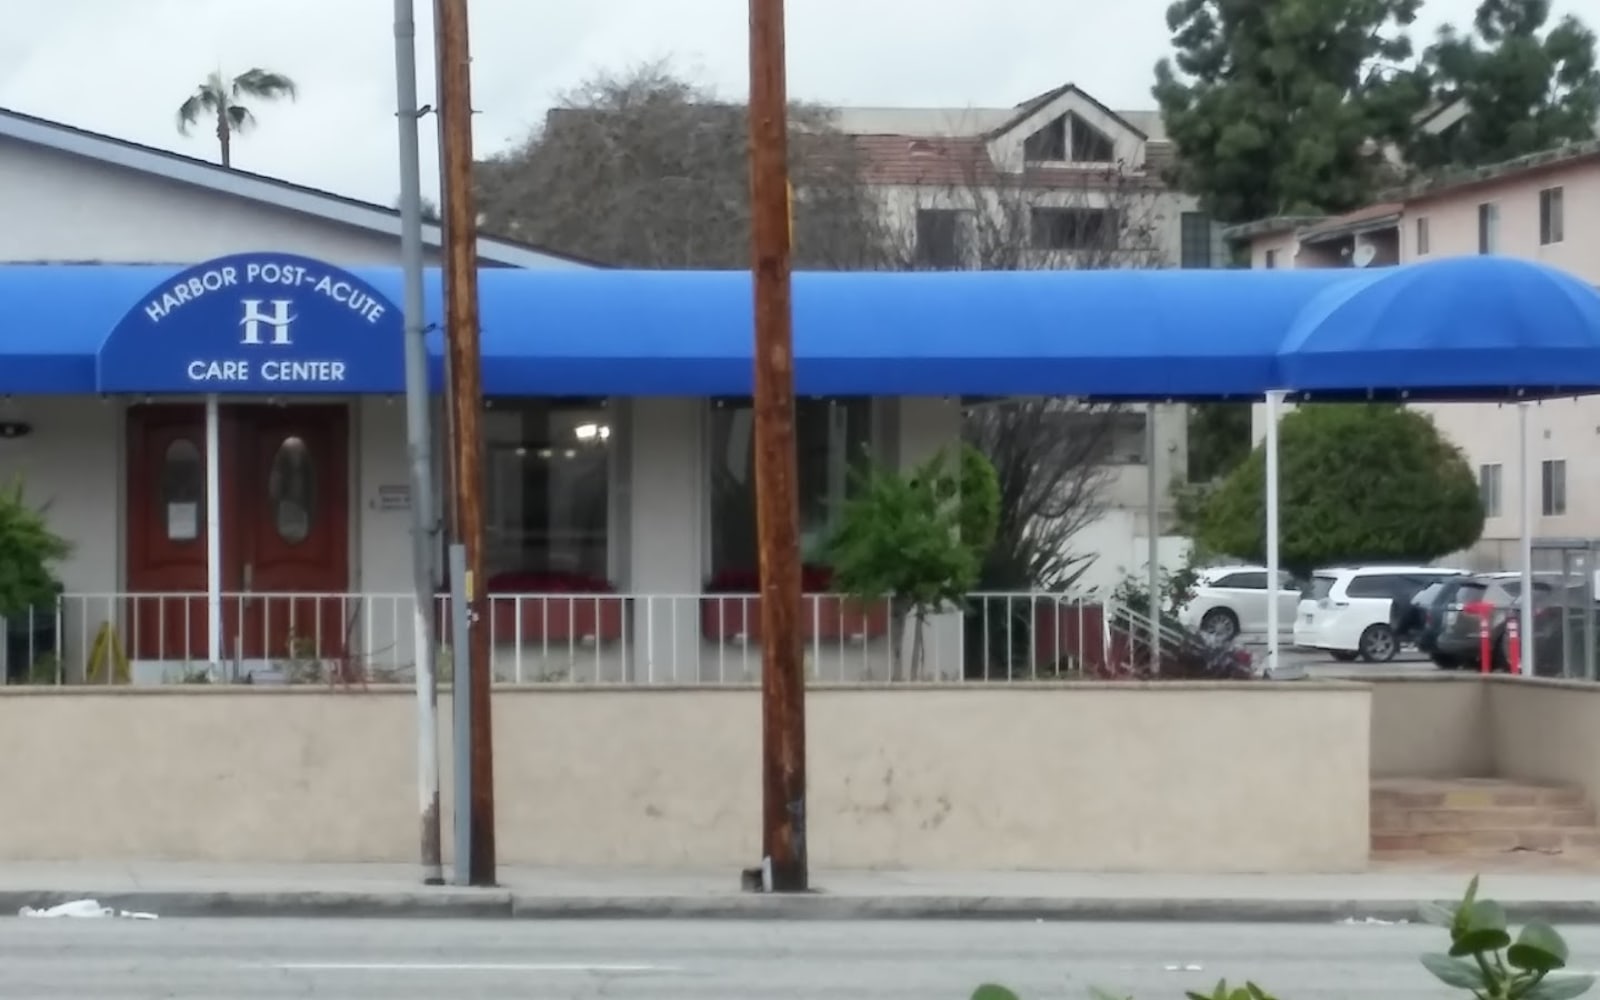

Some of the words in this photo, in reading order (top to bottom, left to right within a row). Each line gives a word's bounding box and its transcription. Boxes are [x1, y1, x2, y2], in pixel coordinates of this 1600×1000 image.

[145, 266, 238, 323] HARBOR
[247, 263, 385, 325] POST-ACUTE
[239, 299, 298, 345] H
[188, 361, 248, 381] CARE
[261, 361, 346, 381] CENTER
